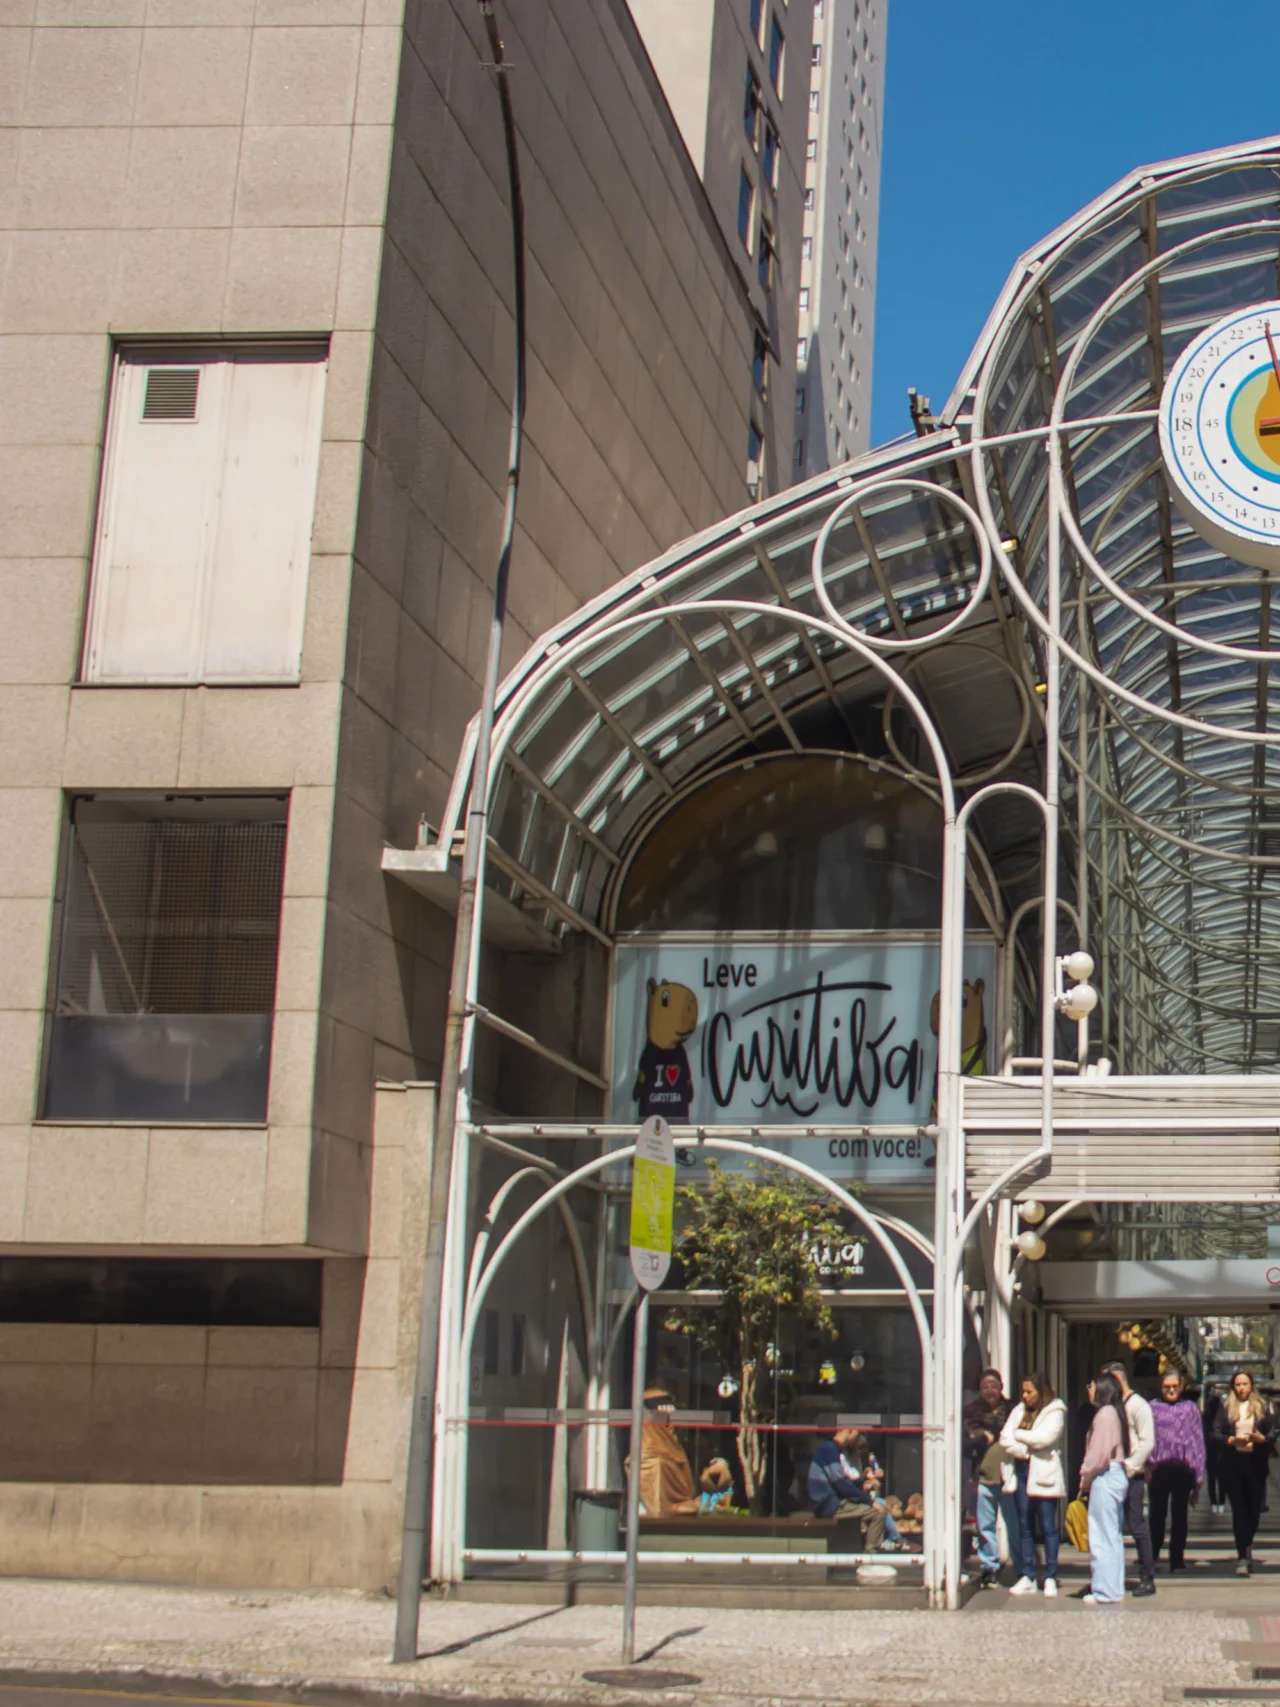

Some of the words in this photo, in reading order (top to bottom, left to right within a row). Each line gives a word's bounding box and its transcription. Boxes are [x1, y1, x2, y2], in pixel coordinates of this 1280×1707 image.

[1229, 329, 1245, 340] 22
[1207, 346, 1221, 357] 21
[1189, 367, 1205, 378] 20
[1179, 392, 1194, 403] 19
[1174, 417, 1193, 432] 18
[1205, 418, 1220, 429] 45
[1181, 445, 1194, 456] 17
[1192, 470, 1207, 481] 16
[1210, 491, 1225, 502] 15
[1234, 507, 1248, 519] 14
[1261, 517, 1276, 529] 13
[703, 958, 757, 987] Leve
[708, 971, 918, 1107] Curitiba
[828, 1138, 868, 1158] com
[820, 1265, 838, 1275] CO
